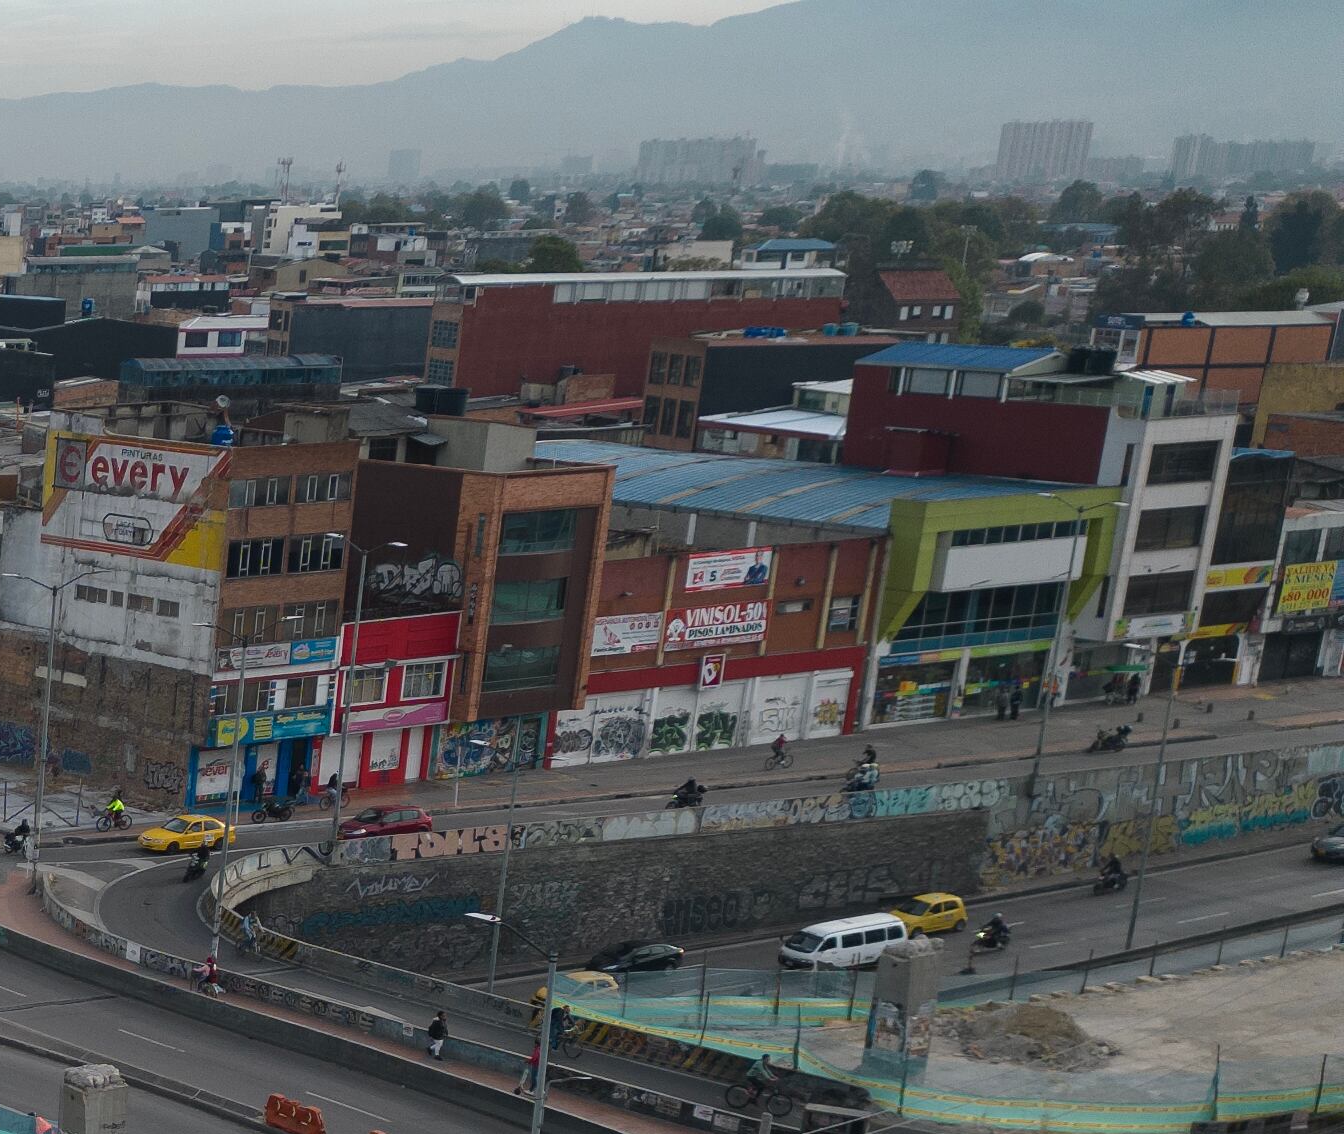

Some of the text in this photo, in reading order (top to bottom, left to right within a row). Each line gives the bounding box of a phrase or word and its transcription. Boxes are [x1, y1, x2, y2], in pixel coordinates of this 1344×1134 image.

[121, 448, 163, 462] PINTURAS
[91, 455, 190, 500] every
[688, 627, 714, 639] PISOS
